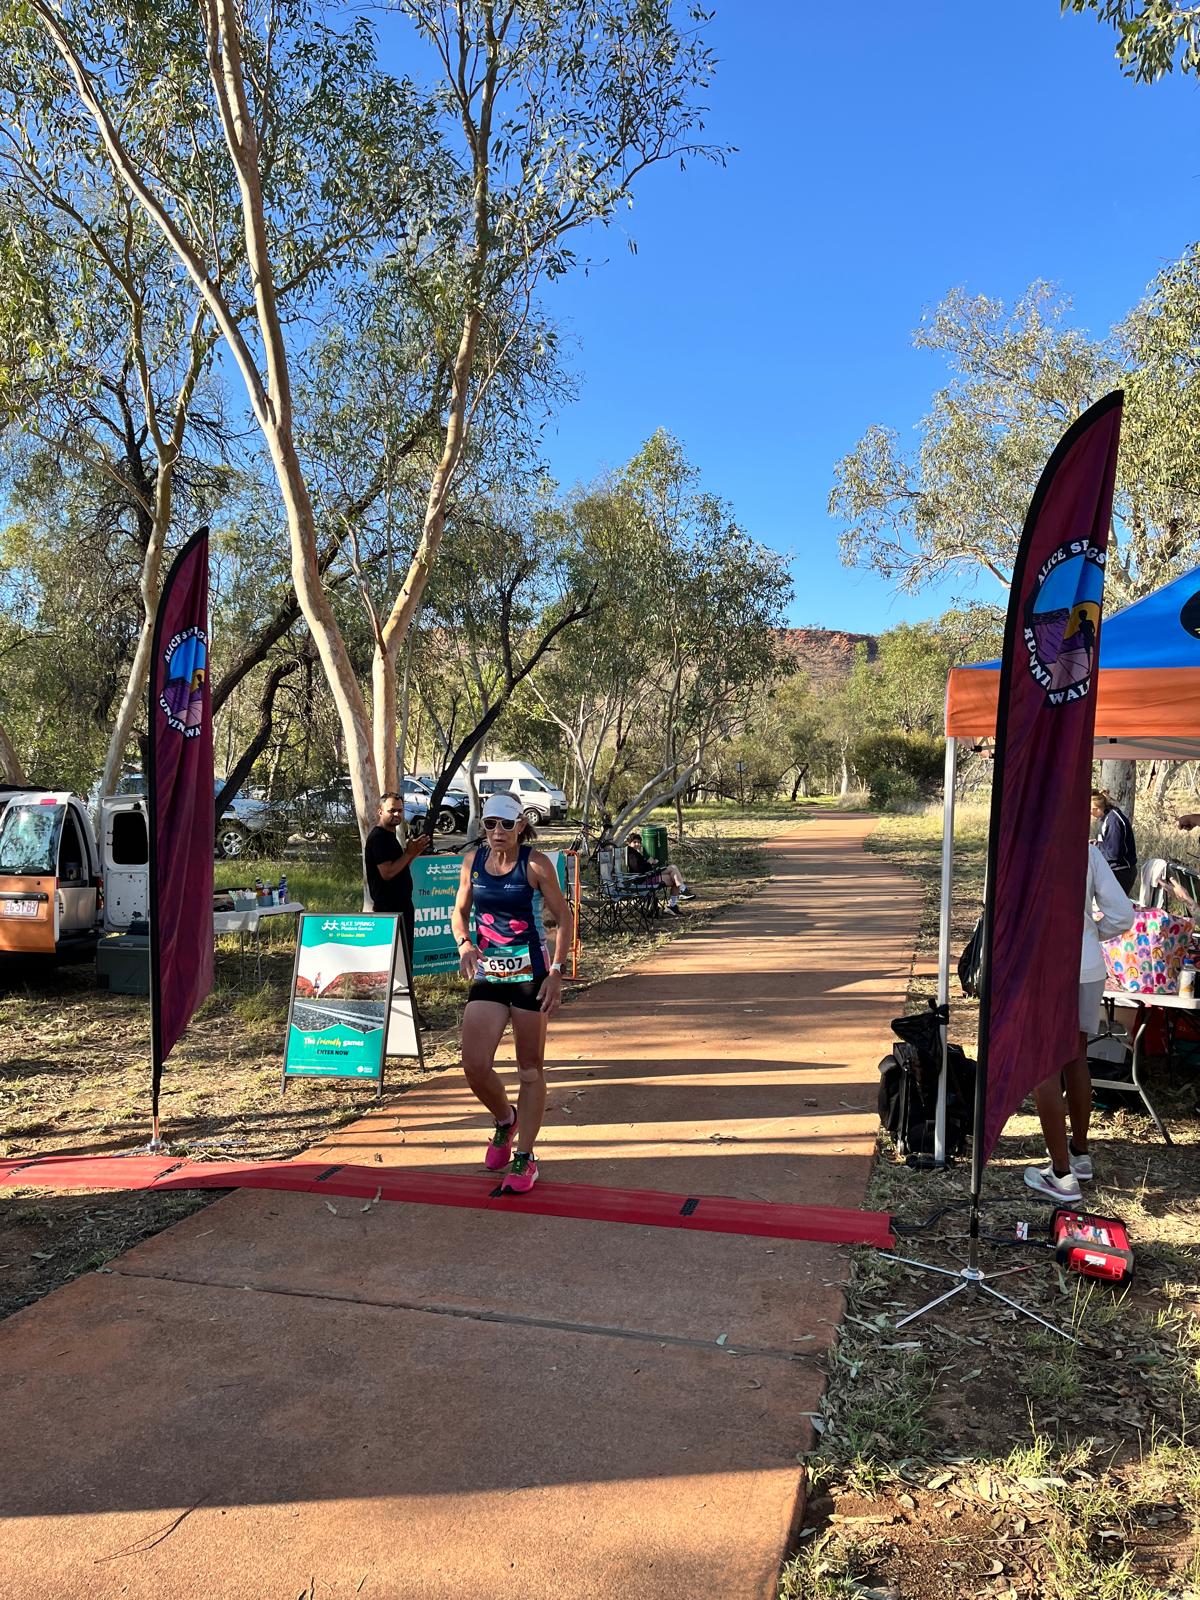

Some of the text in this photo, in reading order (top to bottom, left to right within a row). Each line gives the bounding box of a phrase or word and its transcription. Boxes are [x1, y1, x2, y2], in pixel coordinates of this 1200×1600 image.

[1038, 548, 1066, 586] ALICE
[164, 634, 182, 663] ALICE
[1024, 628, 1052, 690] RUNNI
[414, 924, 451, 938] ROAD &
[424, 954, 438, 962] FIND
[440, 952, 452, 960] OUT
[489, 958, 523, 970] 6507
[304, 1037, 315, 1045] The
[316, 1036, 341, 1048] friendly
